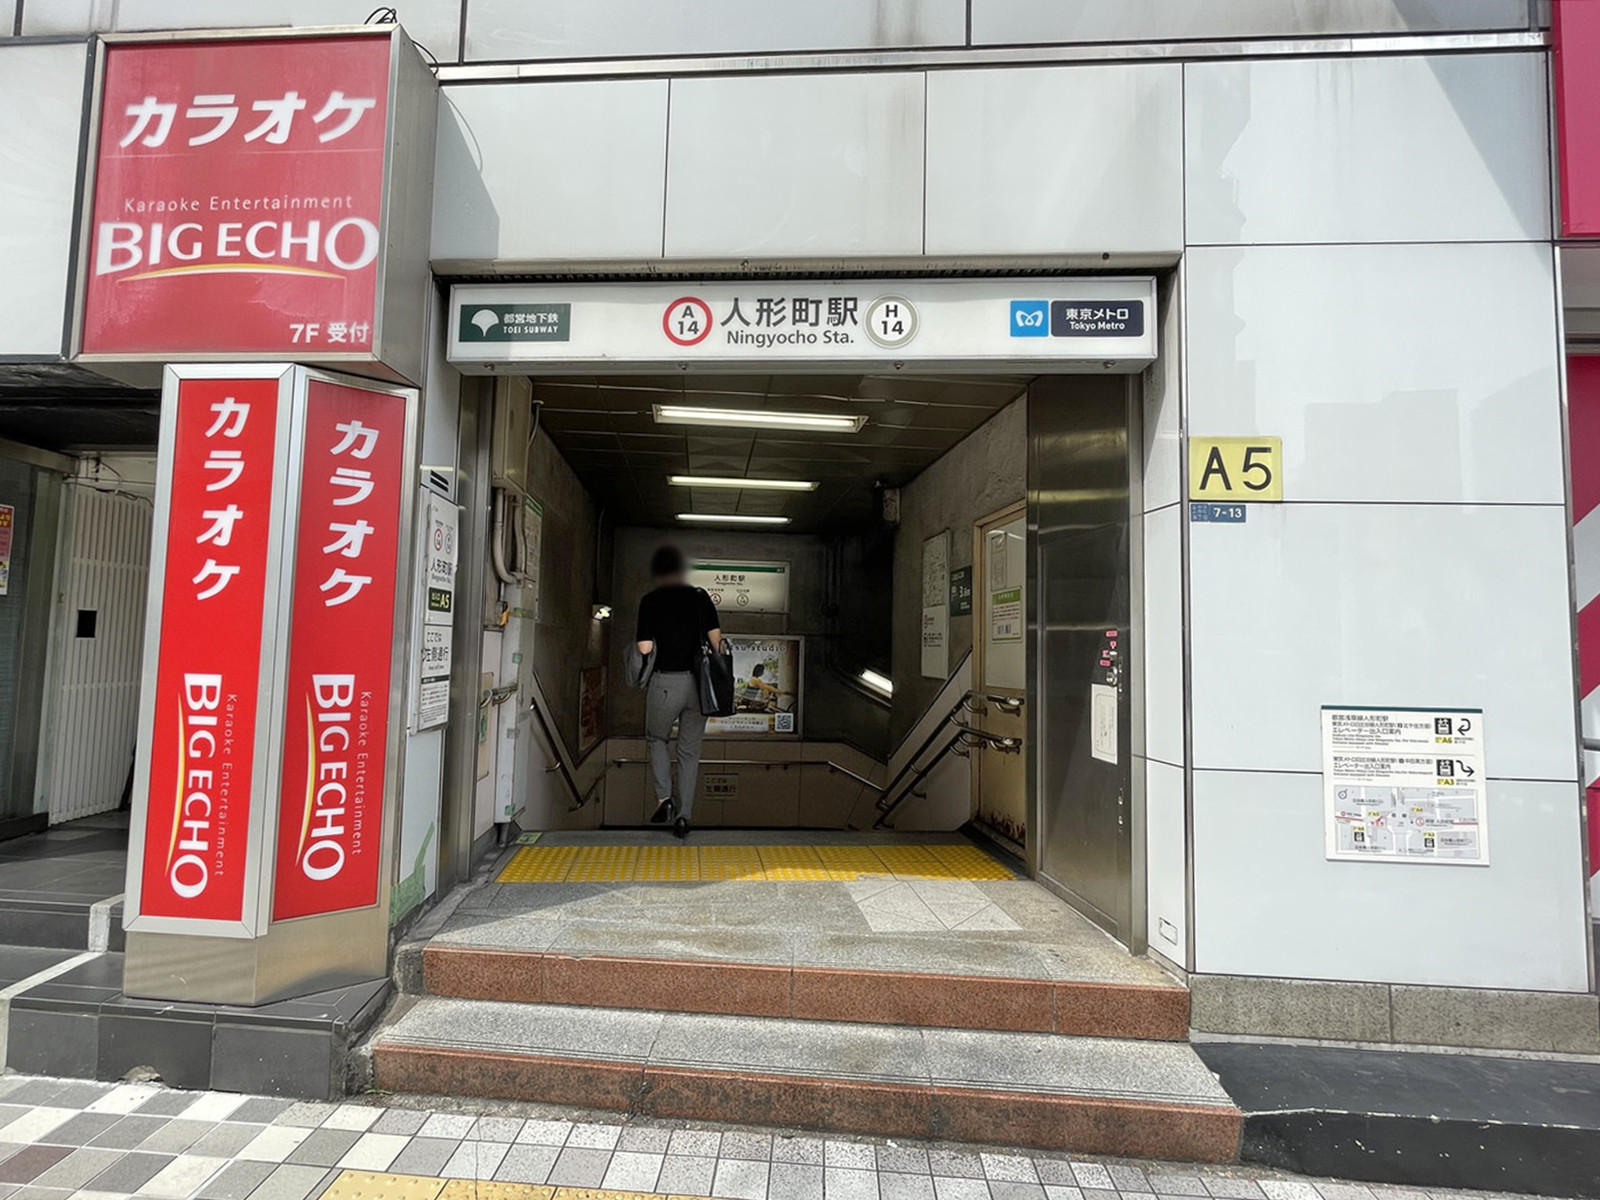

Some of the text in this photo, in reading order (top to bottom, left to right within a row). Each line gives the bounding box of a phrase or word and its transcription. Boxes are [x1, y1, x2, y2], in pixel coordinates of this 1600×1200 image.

[119, 91, 376, 148] カラオケ
[124, 195, 353, 212] Karaoke Entertainment
[96, 217, 380, 276] BIG ECHO
[503, 312, 558, 324] 都営地下鉄
[682, 307, 694, 318] A
[720, 297, 858, 327] 人形町駅
[885, 304, 898, 317] H
[1065, 308, 1129, 320] 東京メトロ
[289, 322, 370, 343] 7F 受付
[503, 325, 558, 334] TOEI SUBWAY
[678, 321, 699, 335] 14
[881, 321, 904, 335] 14
[1069, 321, 1126, 332] Tokyo Metro
[727, 330, 854, 348] Ningyocho Sta.
[1199, 446, 1272, 490] A5
[192, 397, 250, 600] カラオケ
[319, 420, 379, 607] カラオケ
[1213, 507, 1242, 518] 7-13
[302, 674, 355, 881] BIG ECHO
[351, 691, 372, 855] Karaoke Entertainment
[171, 673, 222, 898] BIG ECHO
[214, 694, 238, 876] Karaoke Entertainment
